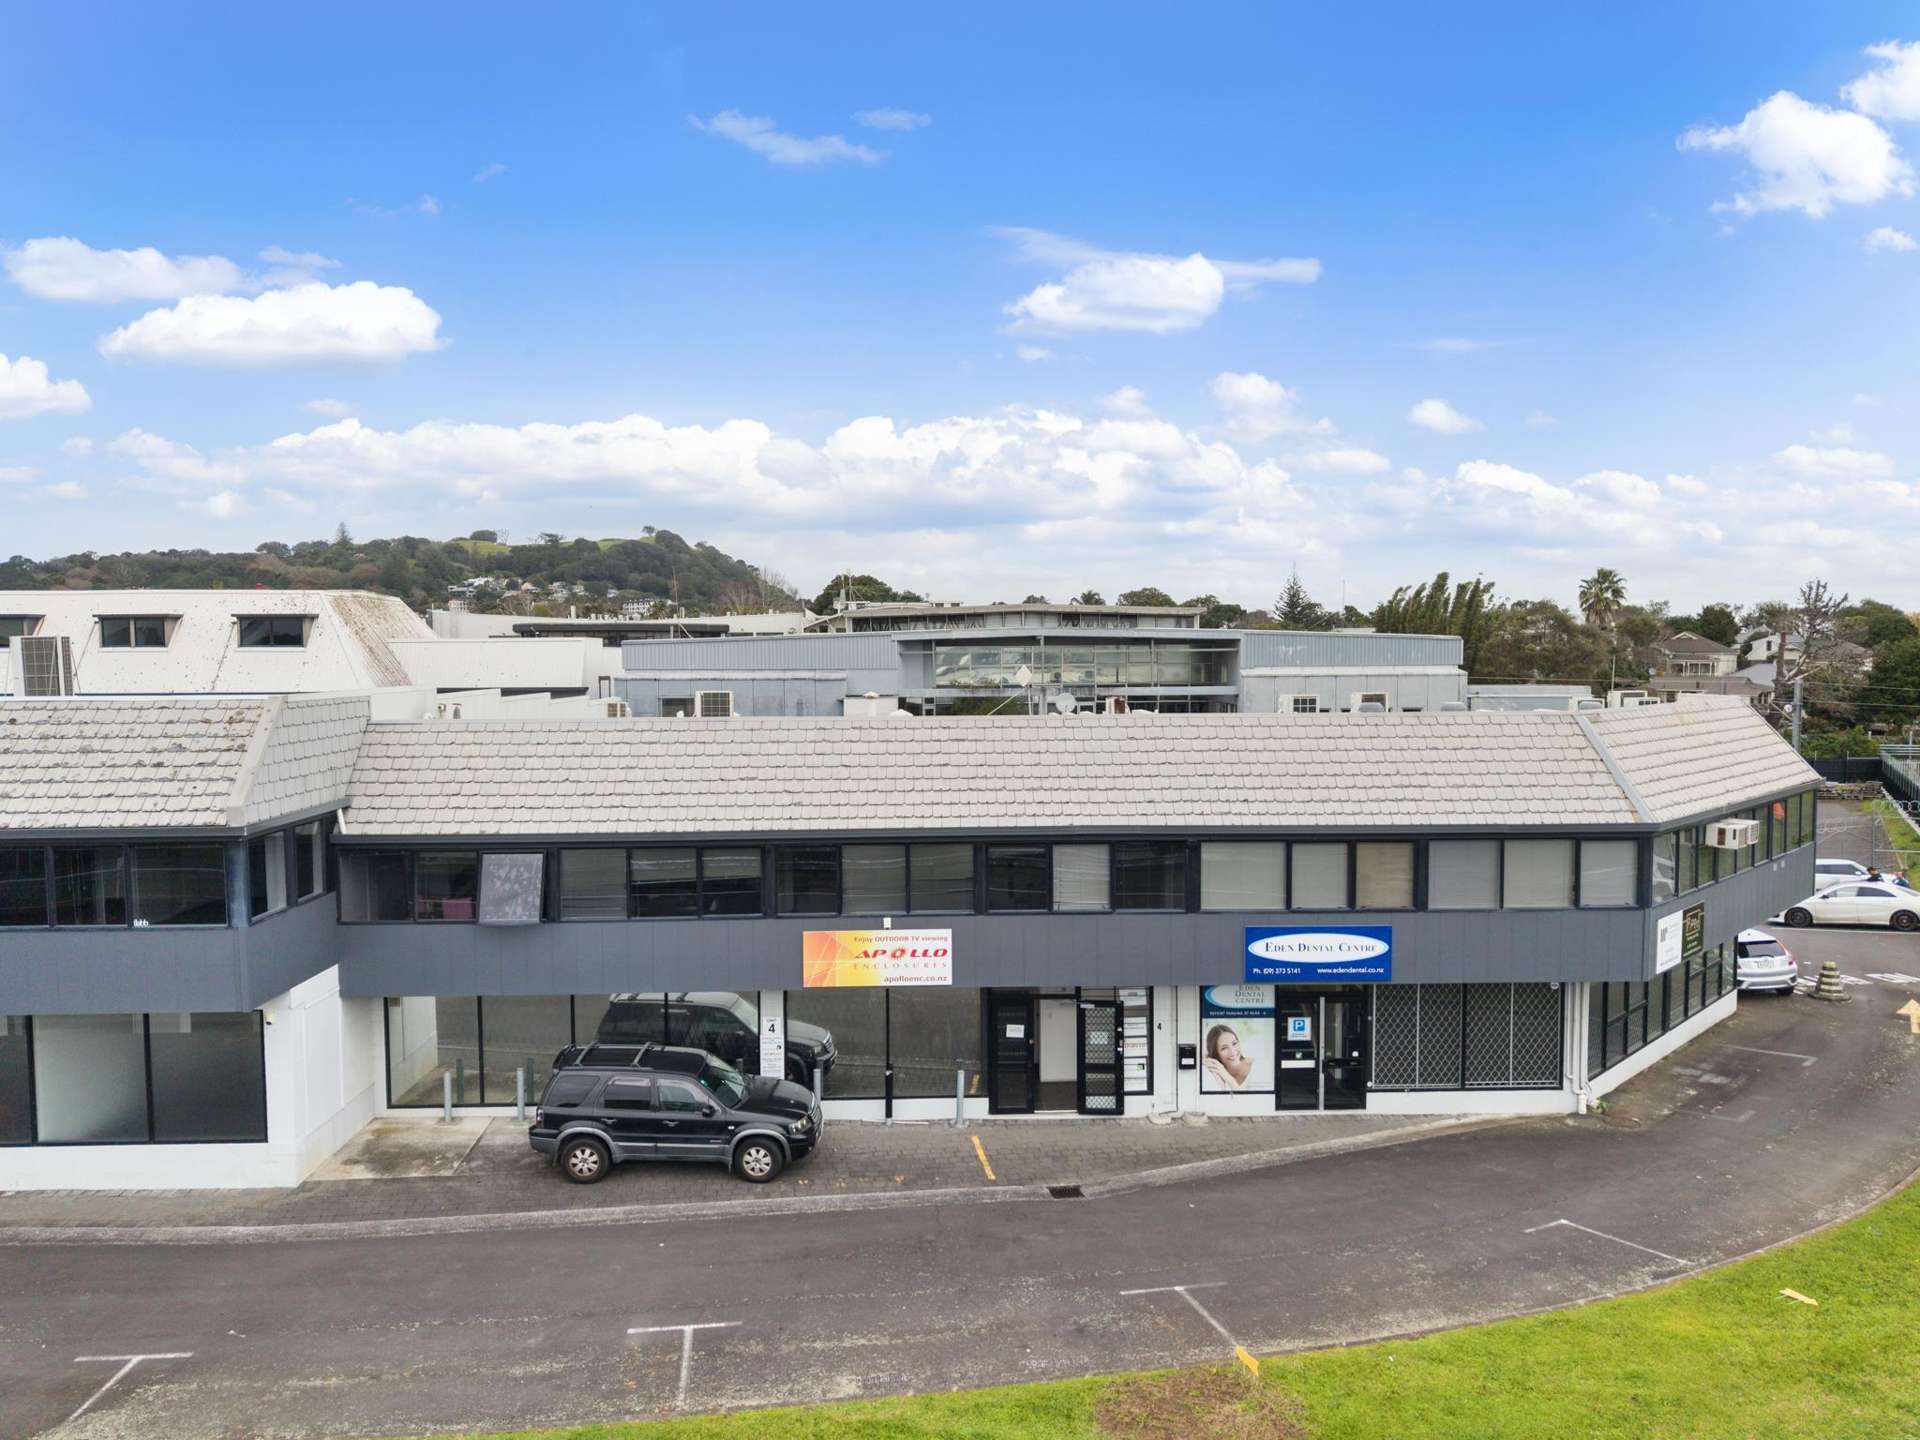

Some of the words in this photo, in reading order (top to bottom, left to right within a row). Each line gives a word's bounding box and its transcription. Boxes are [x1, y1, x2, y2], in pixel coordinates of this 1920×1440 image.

[921, 935, 948, 943] viewing
[855, 948, 948, 959] APOLLO
[1263, 967, 1274, 975] (09)
[884, 975, 948, 983] apolloenc.co.nz
[768, 1023, 776, 1033] 4
